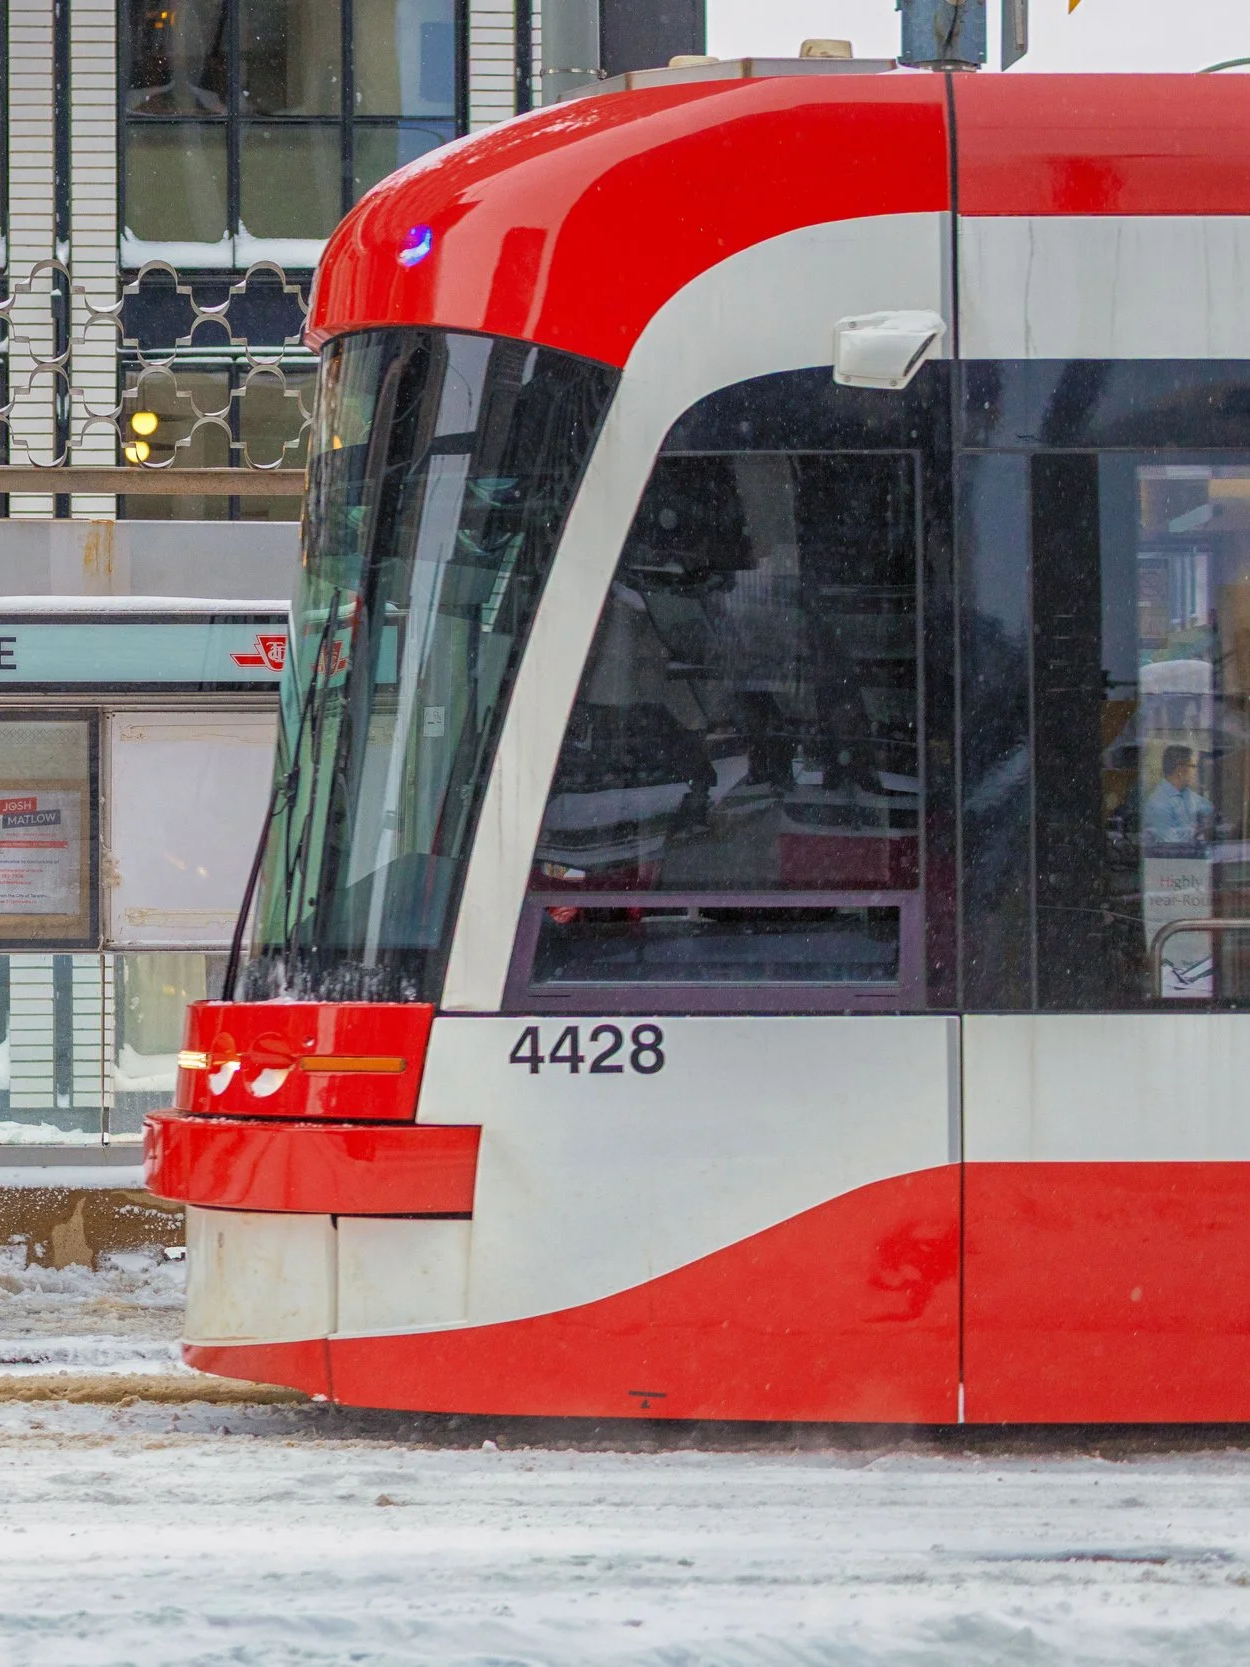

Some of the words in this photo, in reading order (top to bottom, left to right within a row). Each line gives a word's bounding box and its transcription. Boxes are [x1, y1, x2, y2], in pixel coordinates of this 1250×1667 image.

[2, 801, 32, 812] JOSH
[7, 812, 56, 825] MATLOW
[509, 1023, 665, 1075] 4428
